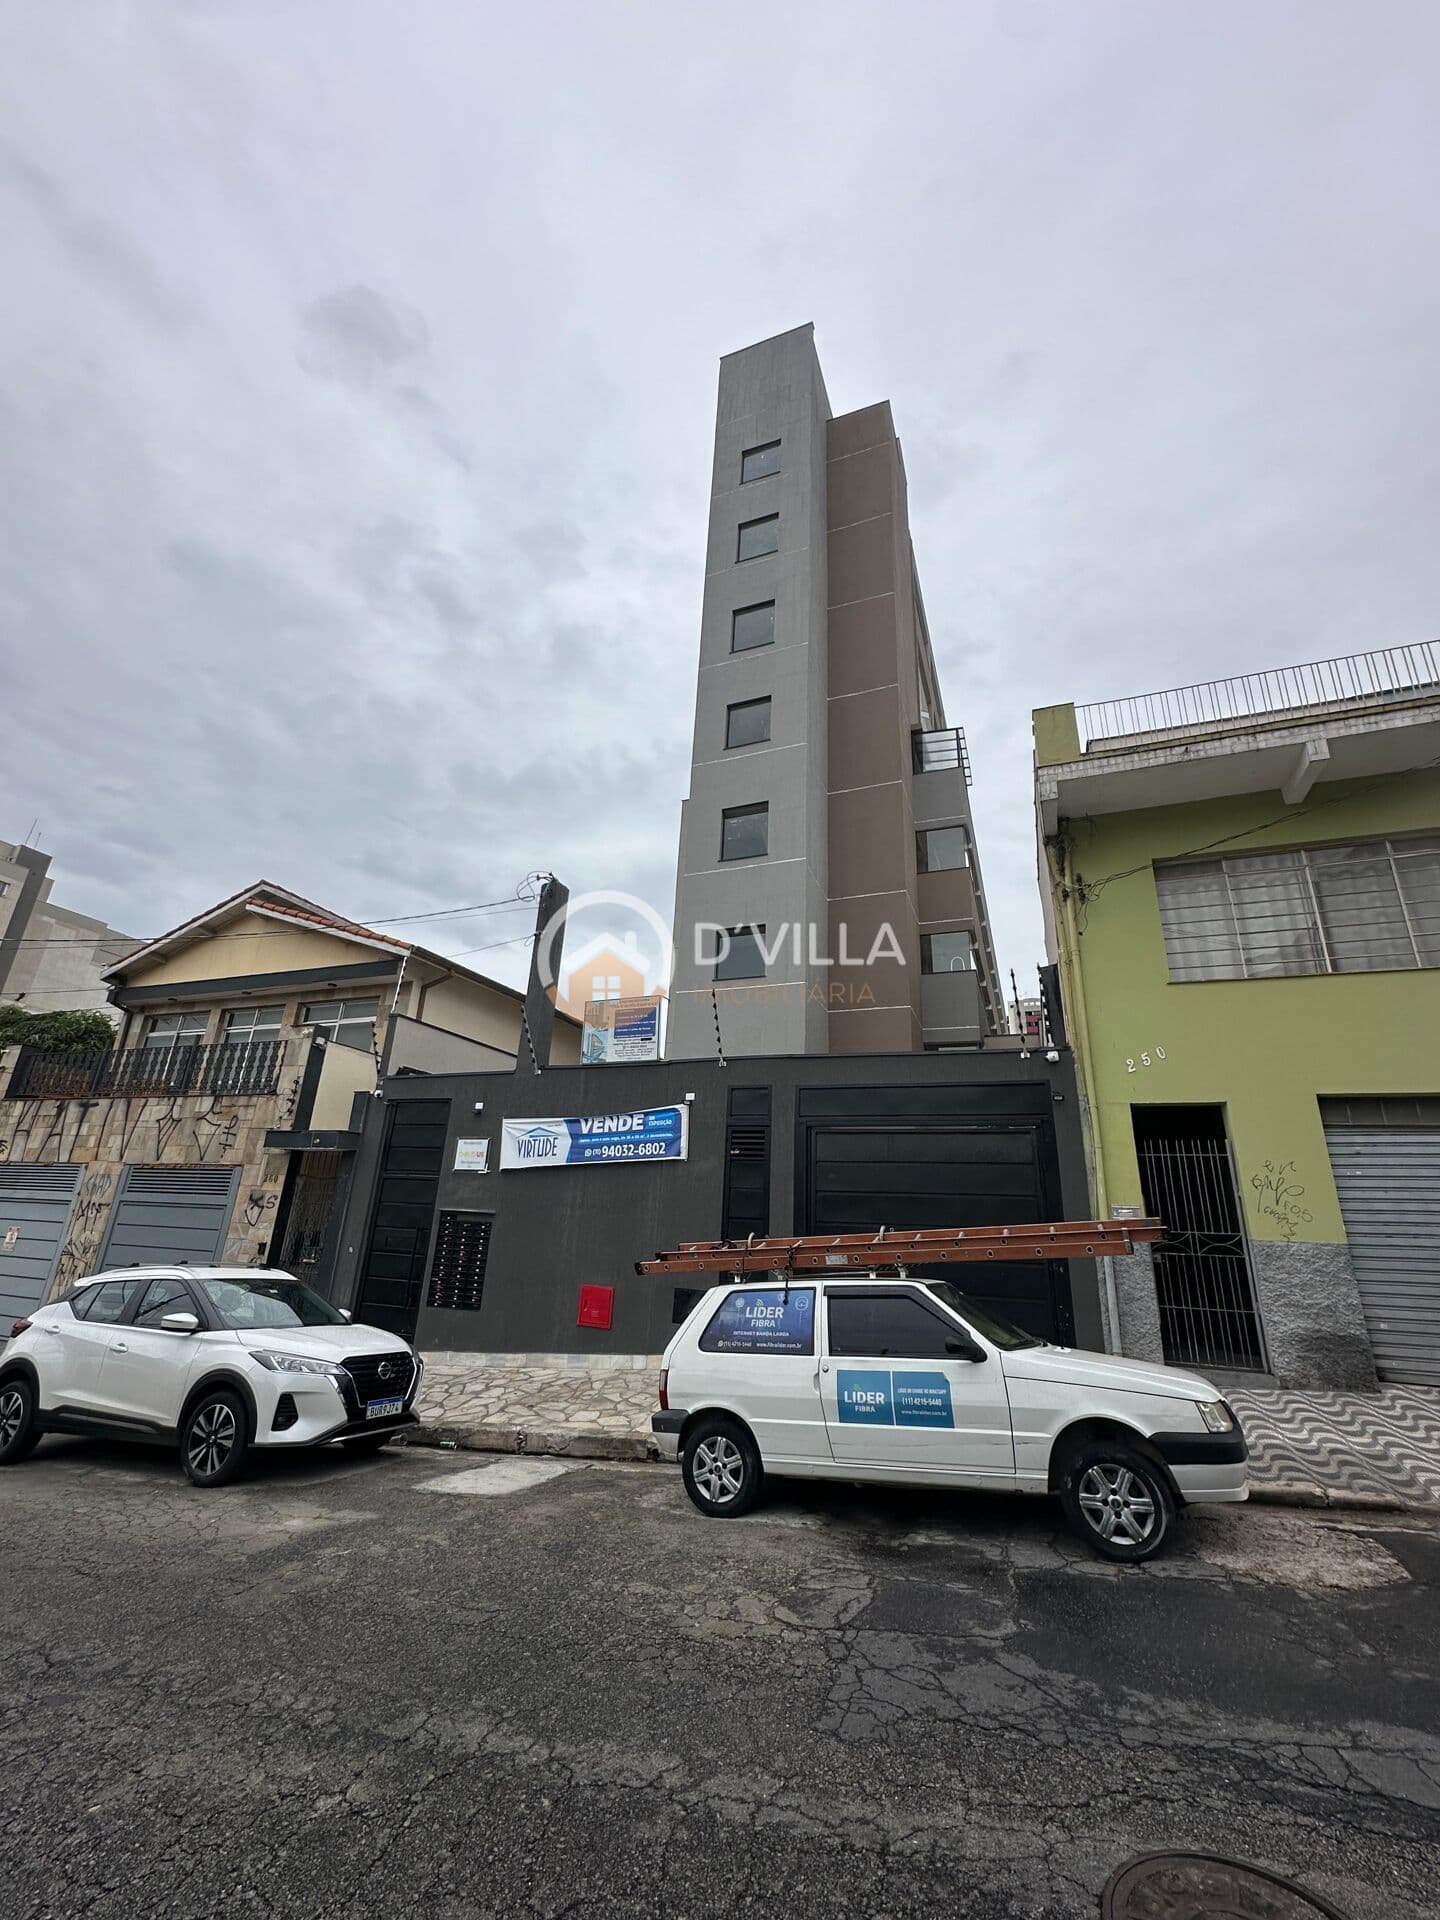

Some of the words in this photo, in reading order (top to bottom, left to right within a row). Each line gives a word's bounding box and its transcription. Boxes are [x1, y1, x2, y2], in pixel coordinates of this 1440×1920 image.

[1126, 1046, 1166, 1073] 250
[580, 1114, 645, 1134] VENDE
[517, 1137, 559, 1158] VIRTUDE
[602, 1142, 666, 1158] 94032-6802
[751, 1319, 776, 1328] FIBRA
[855, 1405, 876, 1413] FIBRA
